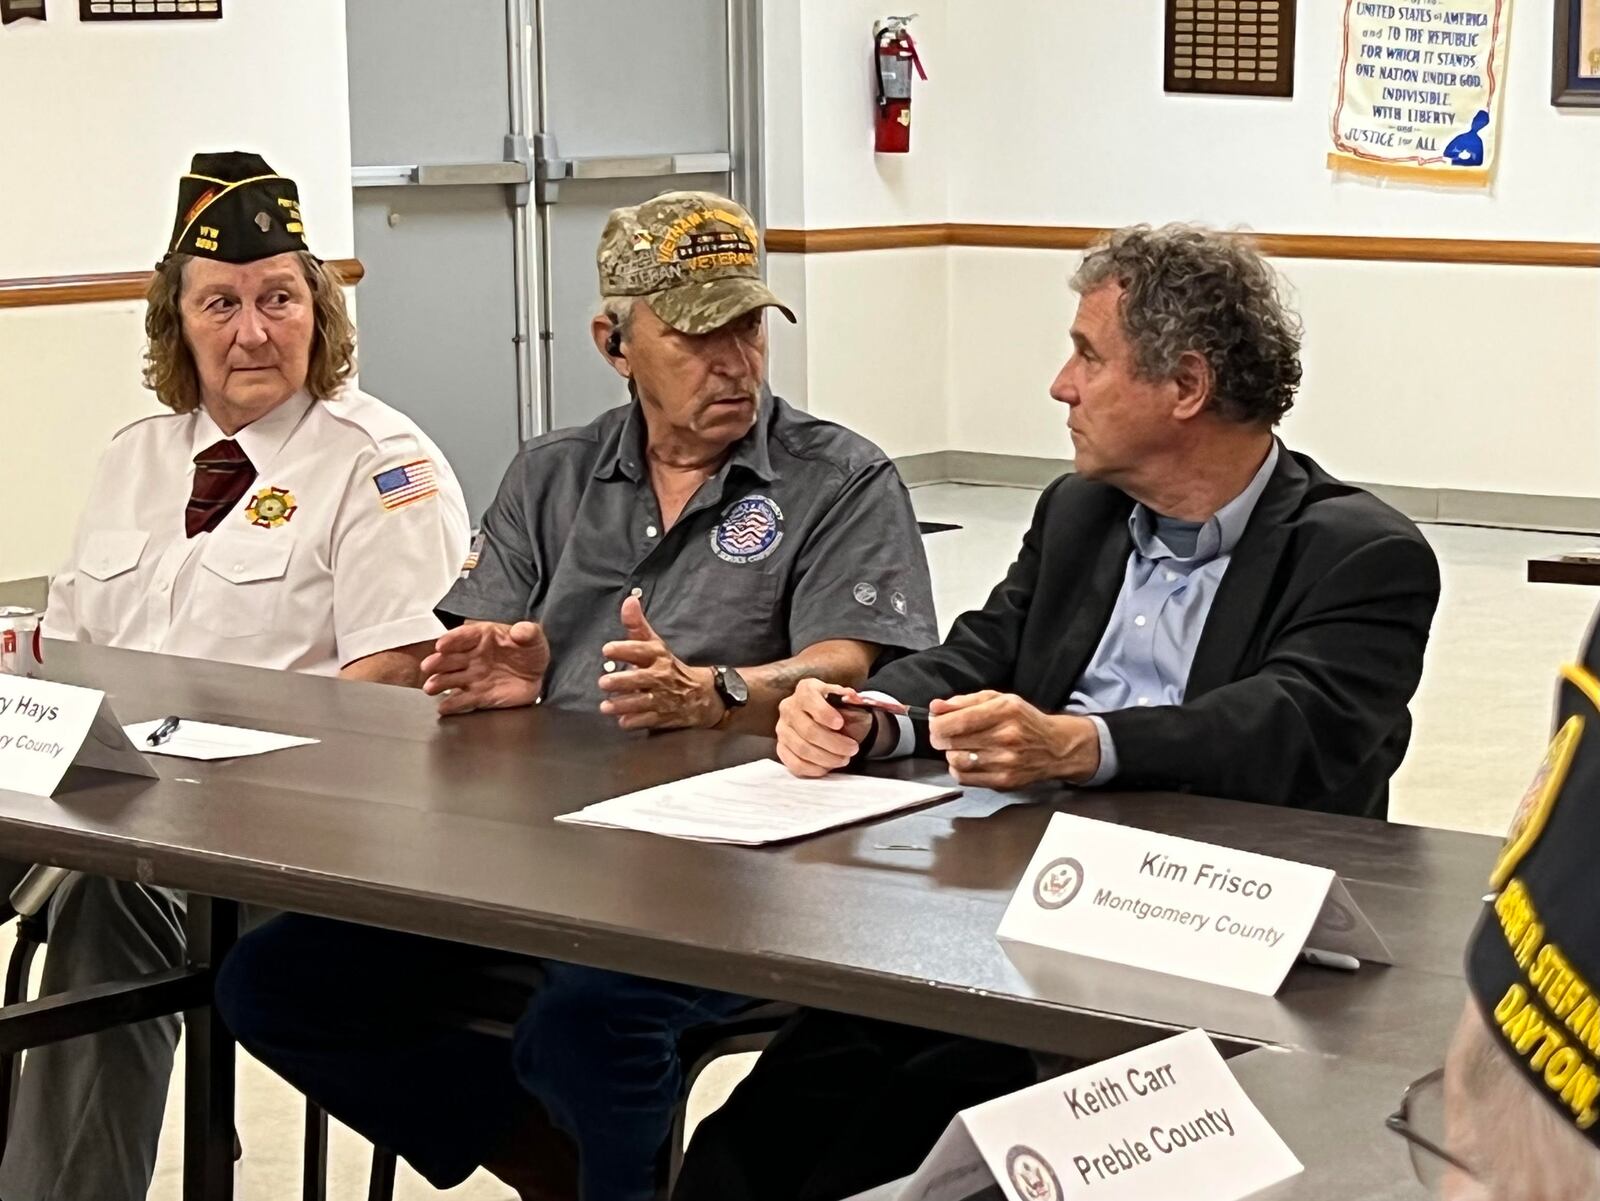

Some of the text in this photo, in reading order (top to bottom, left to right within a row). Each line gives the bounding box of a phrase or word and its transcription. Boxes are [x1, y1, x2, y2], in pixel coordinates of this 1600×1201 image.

[1356, 3, 1395, 19] UNITED
[1399, 7, 1432, 22] STATES
[1443, 12, 1488, 26] AMERICA
[1362, 26, 1479, 47] and TO THE REPUBLIC
[1360, 44, 1382, 59] FOR
[1386, 47, 1420, 63] WHICH
[1423, 51, 1434, 64] IT
[1356, 63, 1375, 78] ONE
[1380, 66, 1419, 83] NATION
[1422, 70, 1456, 87] UNDER
[1373, 105, 1456, 125] WITH LIBERTY
[1344, 128, 1395, 147] JUSTICE
[1416, 137, 1436, 151] ALL
[657, 213, 704, 263] VIETNAM
[688, 252, 755, 270] VETERAN
[14, 695, 59, 723] Hays
[16, 735, 64, 758] County
[1139, 851, 1272, 900] Kim Frisco
[1092, 888, 1284, 948] Montgomery County
[1063, 1063, 1177, 1120] Keith Carr
[1073, 1138, 1152, 1185] Preble
[1150, 1107, 1235, 1154] County
